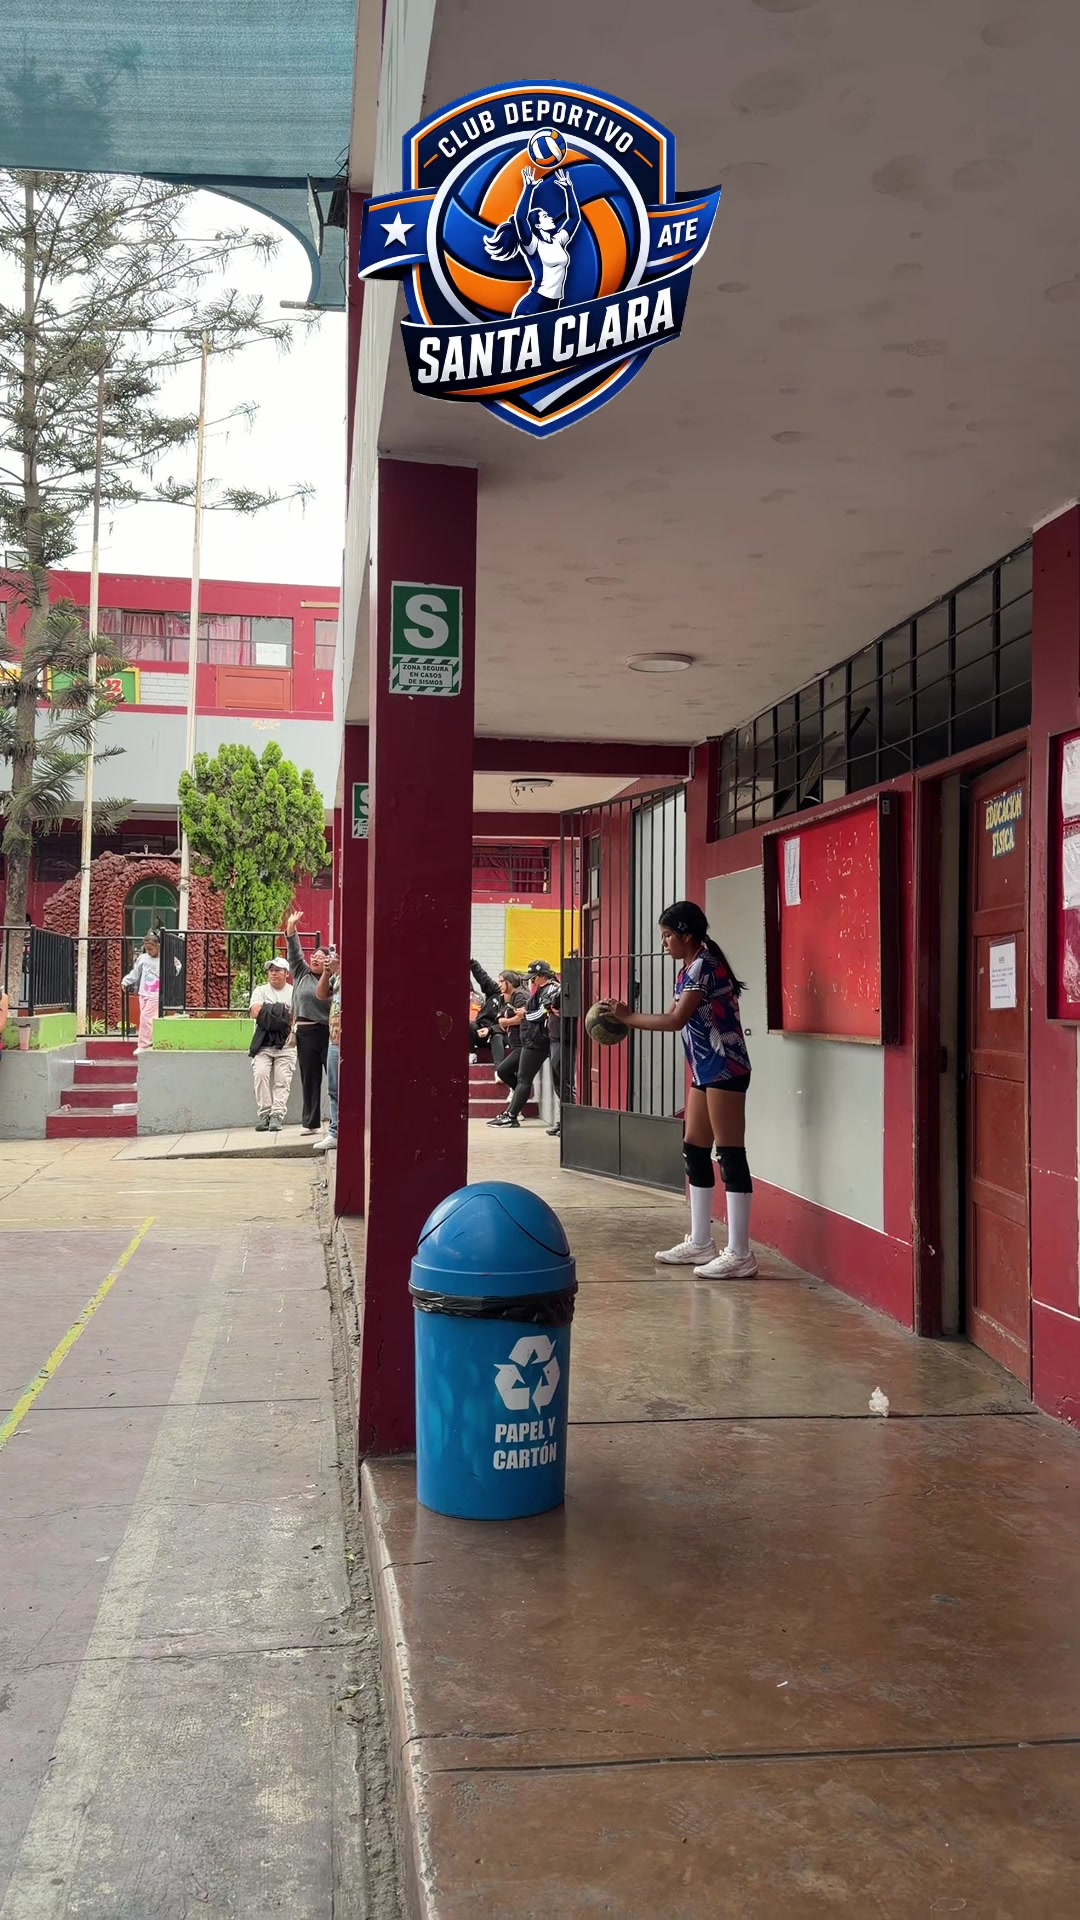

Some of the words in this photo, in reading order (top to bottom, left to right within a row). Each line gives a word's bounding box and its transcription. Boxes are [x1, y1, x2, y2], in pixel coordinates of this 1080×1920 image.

[403, 594, 450, 649] S
[494, 1421, 546, 1444] PAPEL
[547, 1416, 557, 1437] Y
[492, 1440, 557, 1470] CARTÓN
